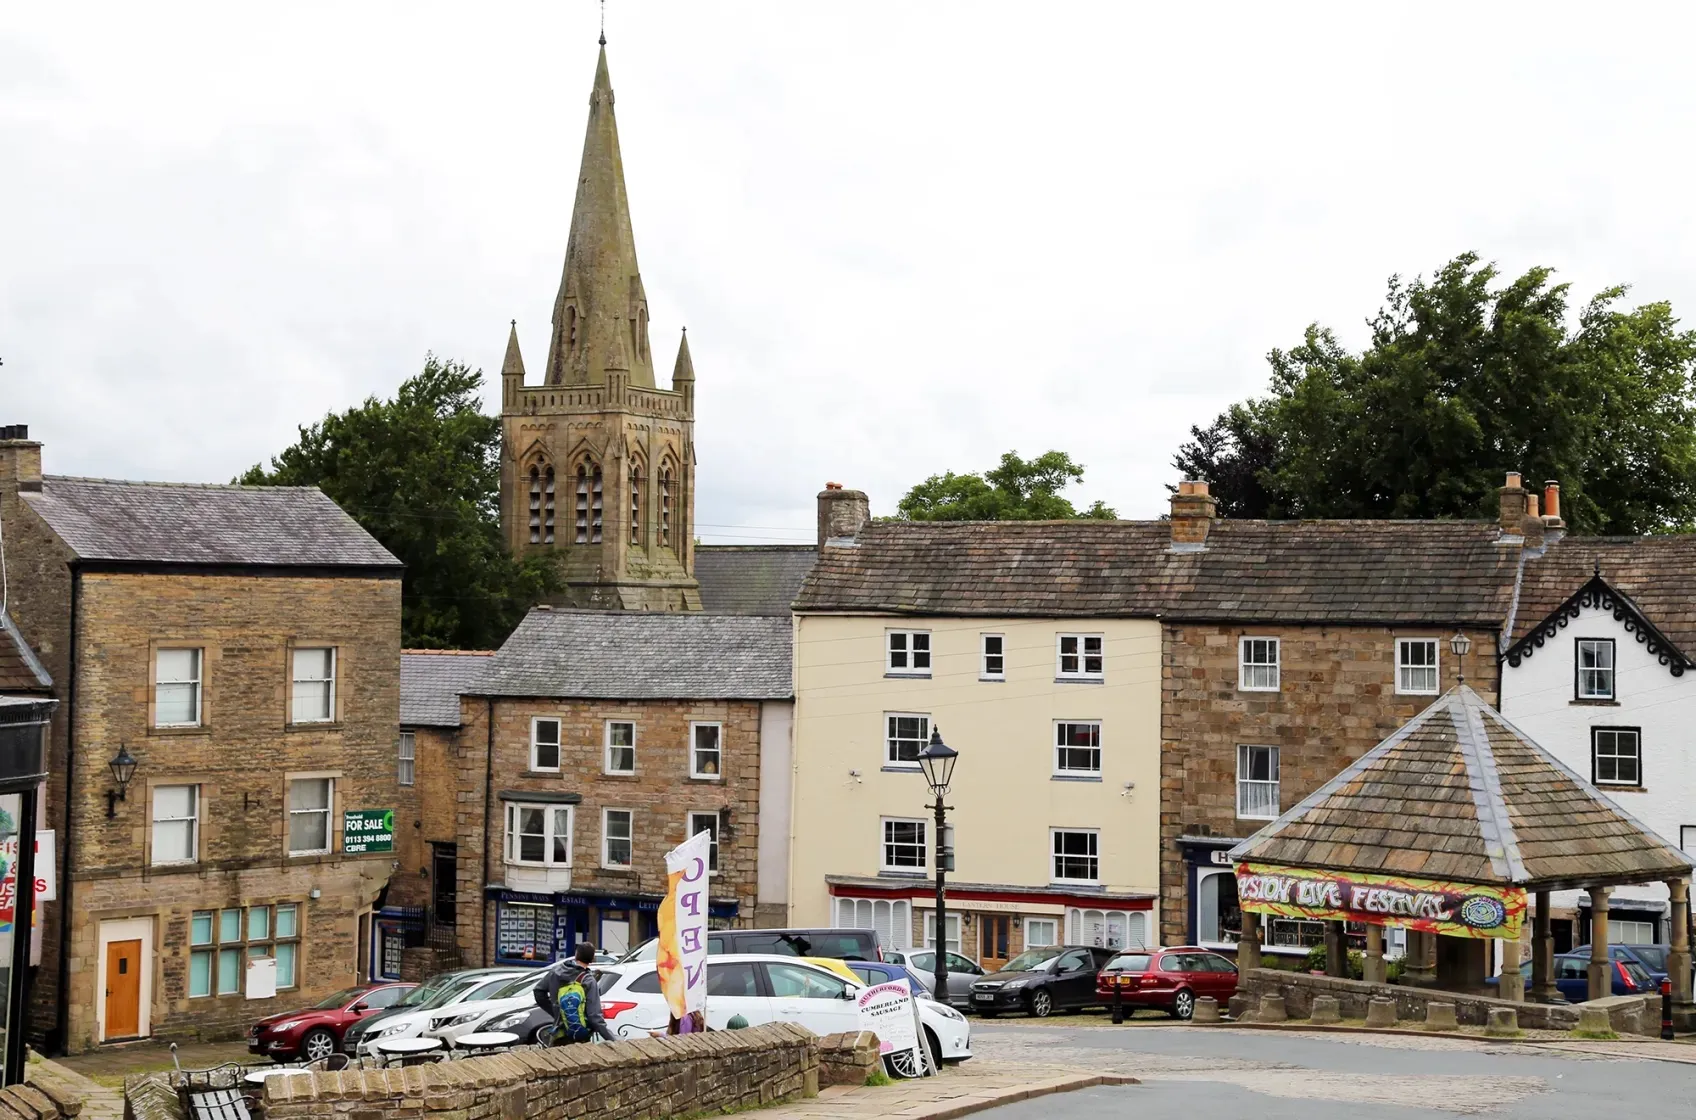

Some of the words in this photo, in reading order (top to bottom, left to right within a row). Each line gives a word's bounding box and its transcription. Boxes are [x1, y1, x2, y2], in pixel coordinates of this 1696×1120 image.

[346, 820, 362, 831] FOR
[364, 819, 383, 830] SALE
[346, 844, 366, 852] CBRE
[561, 895, 587, 904] ESTATE
[609, 899, 617, 907] &
[1297, 880, 1341, 908] LIVE
[1351, 886, 1451, 920] FESTIVAL
[861, 997, 909, 1013] CUMBERLAND
[871, 1006, 903, 1017] SAUSAGE
